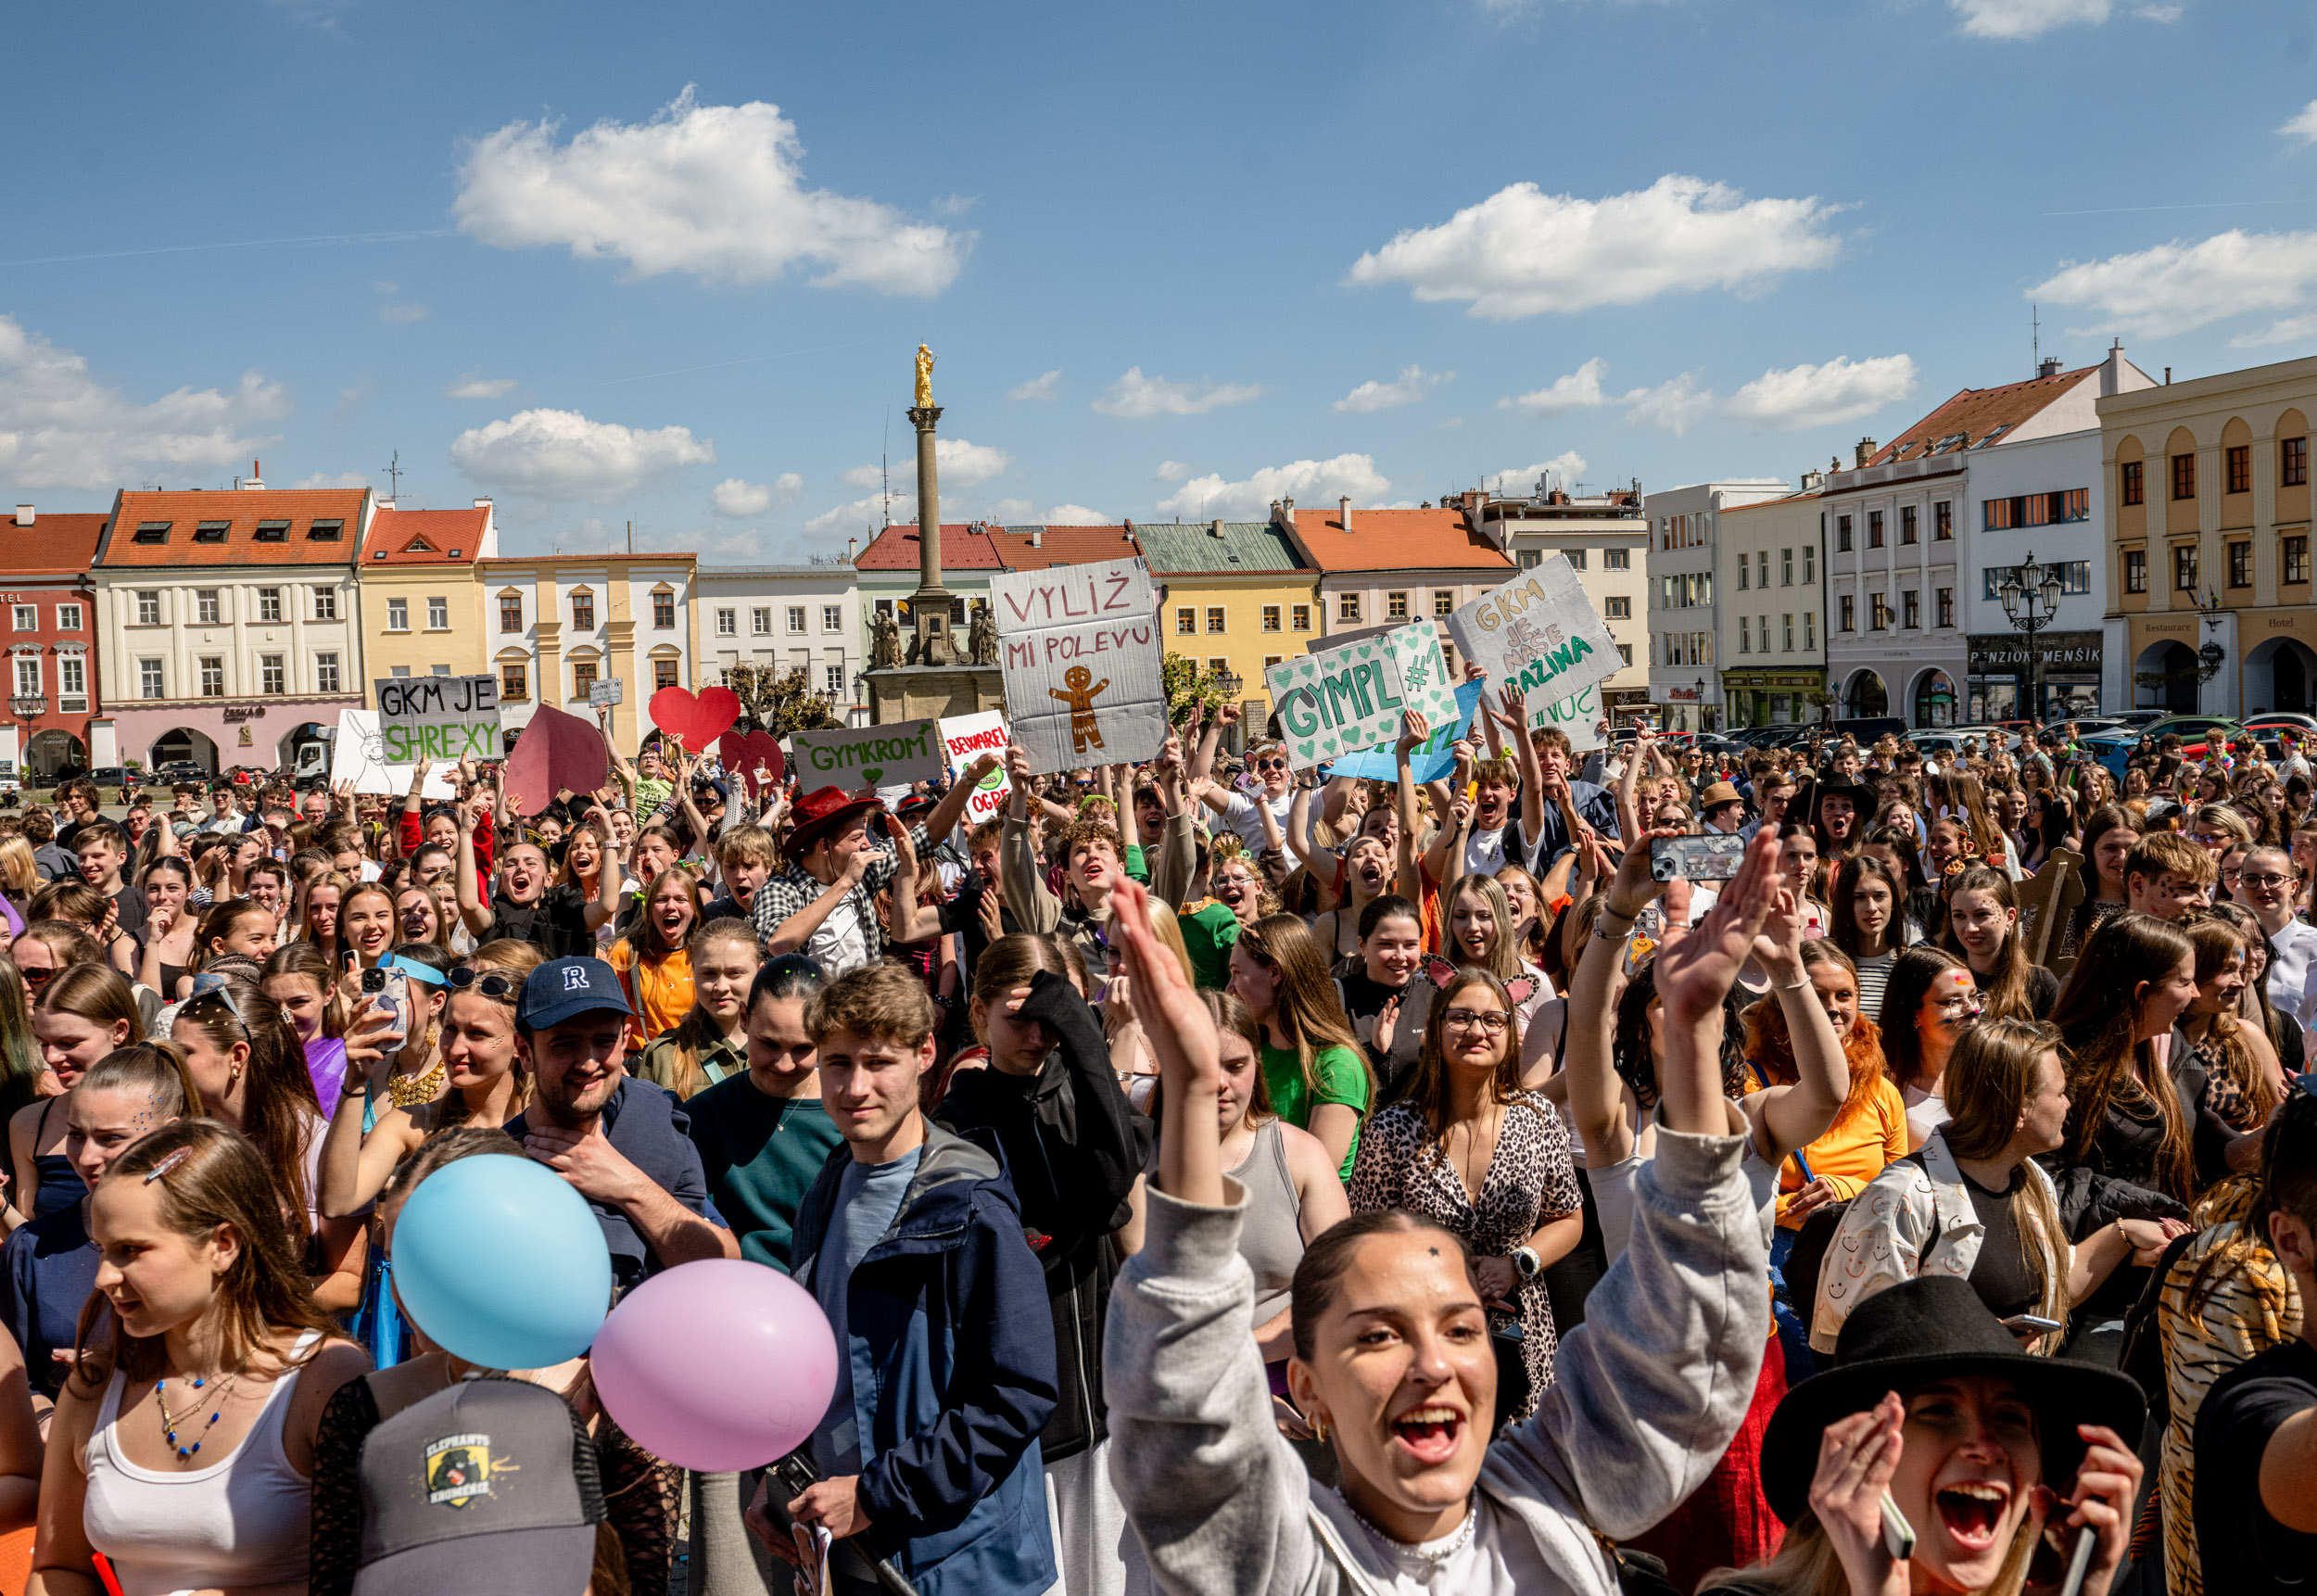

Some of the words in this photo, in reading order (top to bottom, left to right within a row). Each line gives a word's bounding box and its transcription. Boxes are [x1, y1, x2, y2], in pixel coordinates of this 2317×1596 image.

[1475, 577, 1546, 631] GKM
[1507, 617, 1533, 648] JE
[2146, 624, 2191, 632] Restaurace
[2269, 618, 2294, 627] Hotel
[1045, 626, 1150, 664] POLEVU
[1502, 624, 1564, 674] NAŠE
[1970, 652, 2031, 663] PNZION
[2043, 648, 2100, 662] MENŠÍK
[381, 683, 446, 716] GKM
[453, 679, 496, 713] JE
[1285, 659, 1403, 738] GYMPL
[1404, 640, 1446, 692] #1
[385, 722, 499, 762] SHREXY
[810, 733, 928, 771] GYMKROM
[946, 726, 1008, 756] BEWARE!
[562, 966, 590, 990] R
[426, 1434, 490, 1458] ELEPHANTS
